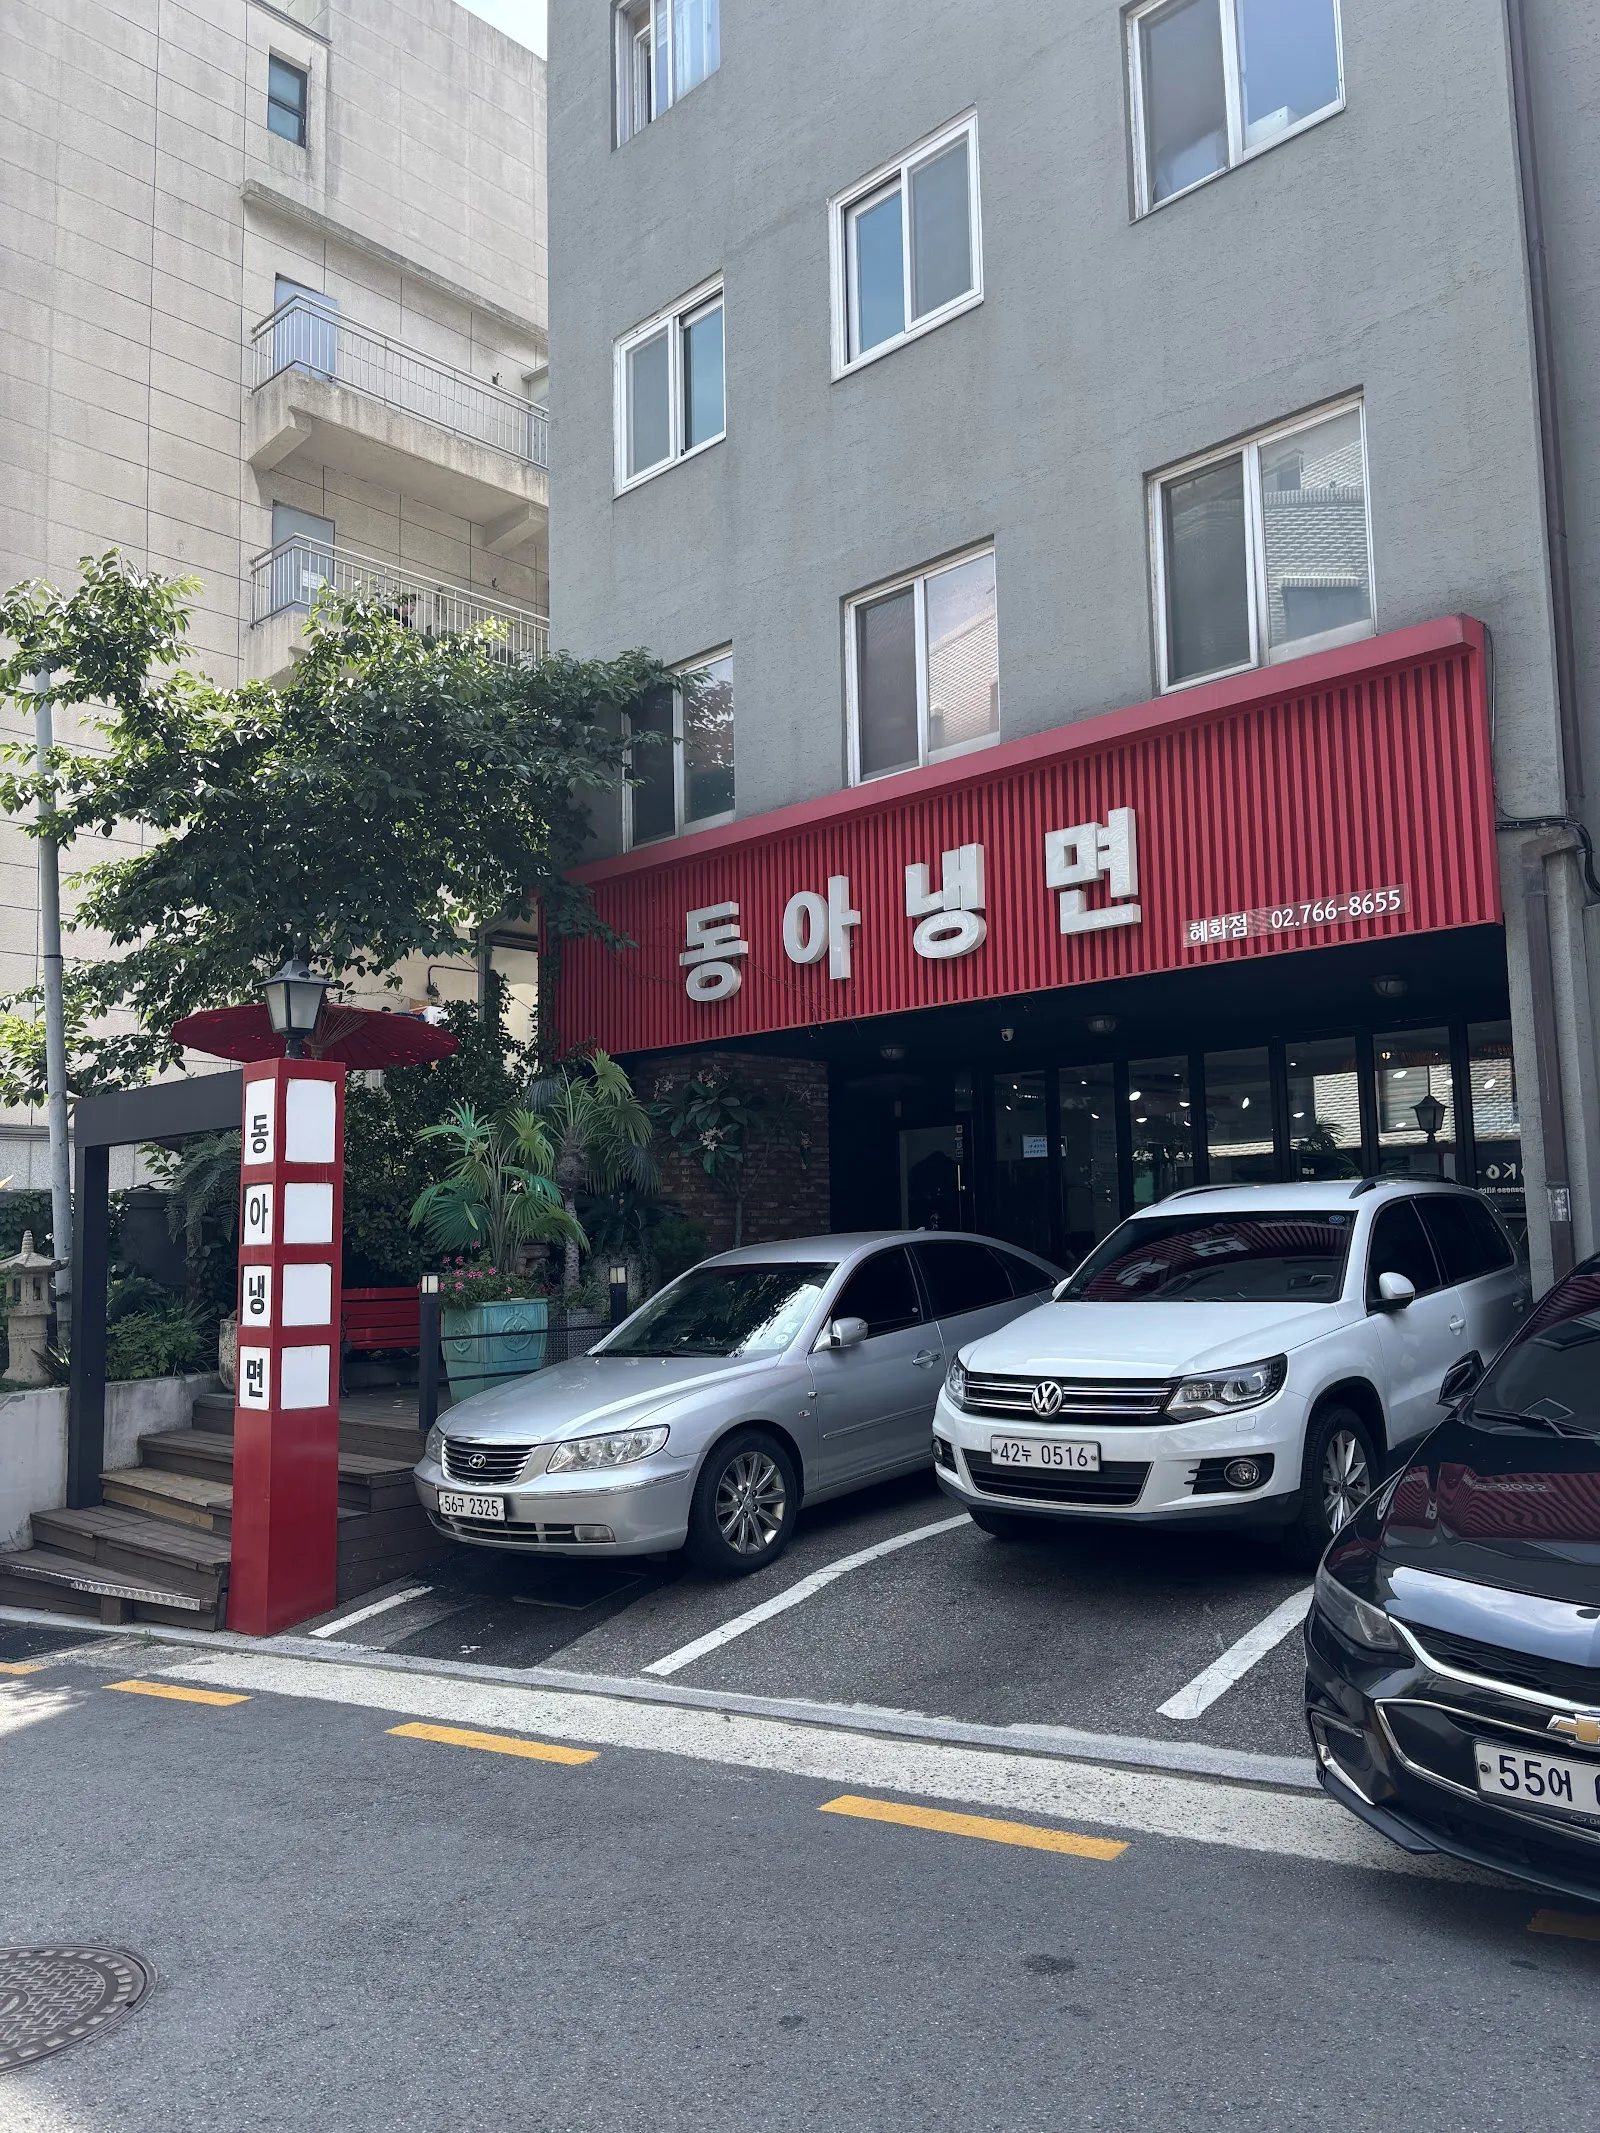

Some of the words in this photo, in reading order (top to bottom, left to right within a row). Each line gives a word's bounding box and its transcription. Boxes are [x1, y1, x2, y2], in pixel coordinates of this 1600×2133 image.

[1189, 912, 1249, 943] 혜화점
[1271, 889, 1401, 929] 02.766-8655
[1000, 1442, 1032, 1463] 42누
[1041, 1444, 1088, 1467] 0516
[444, 1495, 465, 1513] 56구
[469, 1497, 499, 1517] 2325
[1498, 1754, 1573, 1802] 55어
